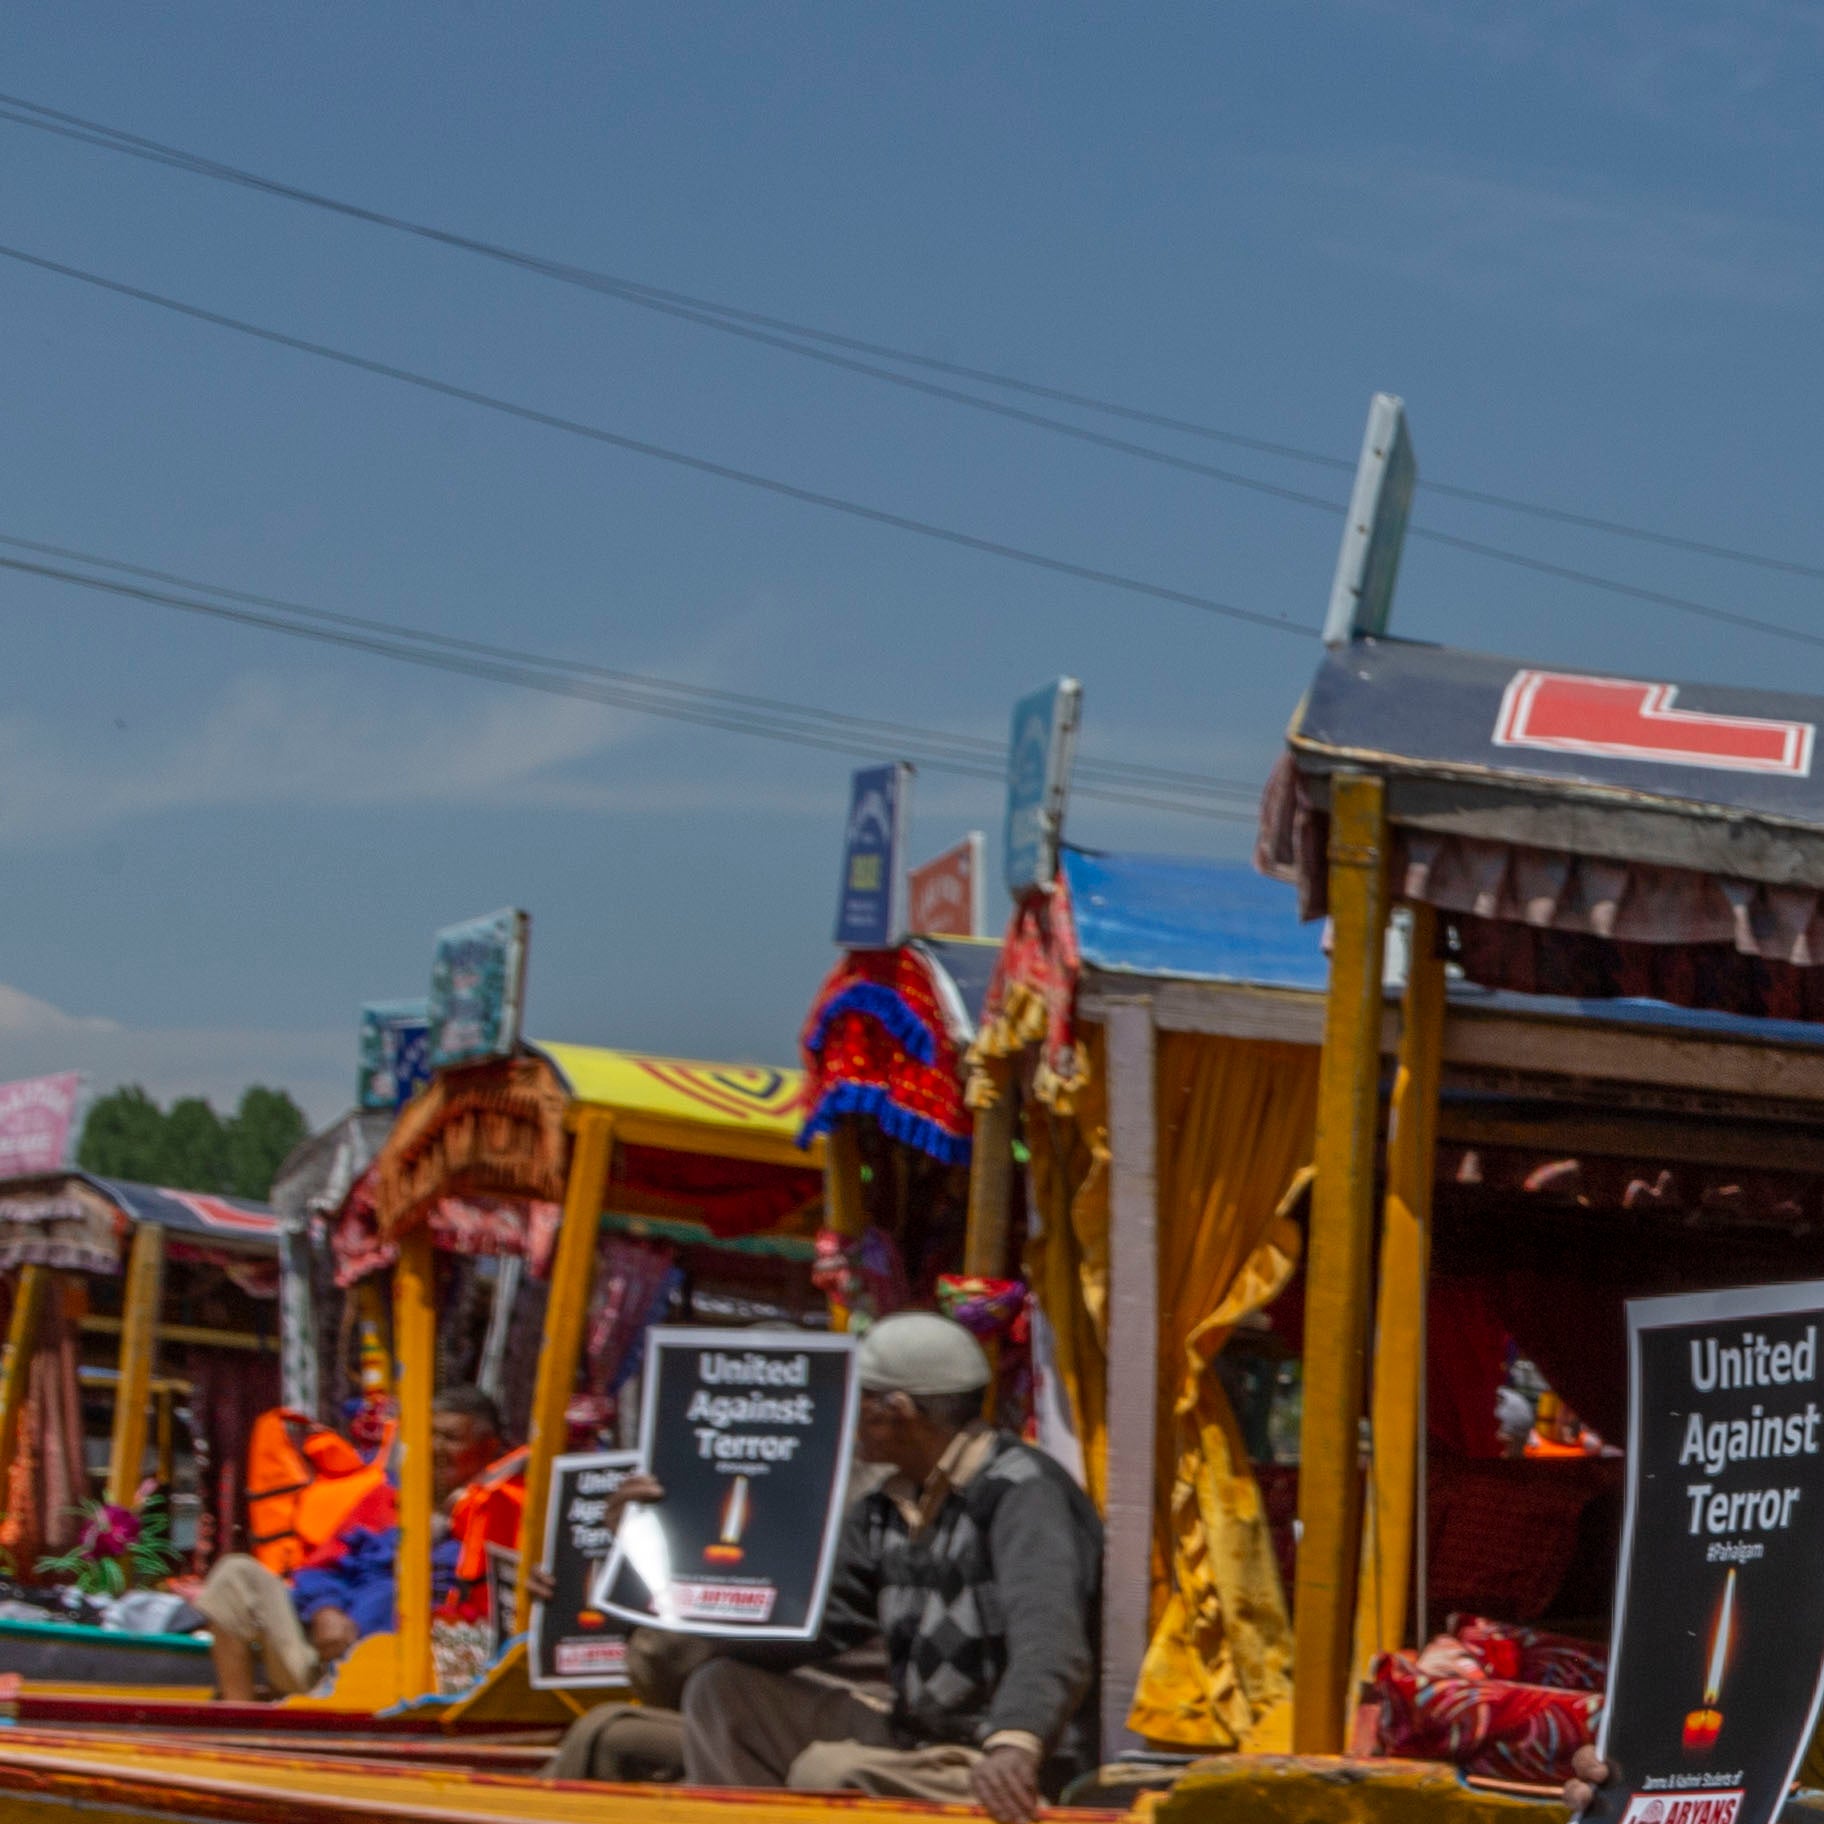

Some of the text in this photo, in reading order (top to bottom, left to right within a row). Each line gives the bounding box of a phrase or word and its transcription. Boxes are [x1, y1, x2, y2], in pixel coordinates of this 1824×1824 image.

[700, 1353, 809, 1386] United
[1689, 1325, 1817, 1392] United
[686, 1390, 815, 1426] Against
[694, 1427, 799, 1461] Terror
[1679, 1403, 1821, 1476] Against
[1687, 1484, 1800, 1534] Terror
